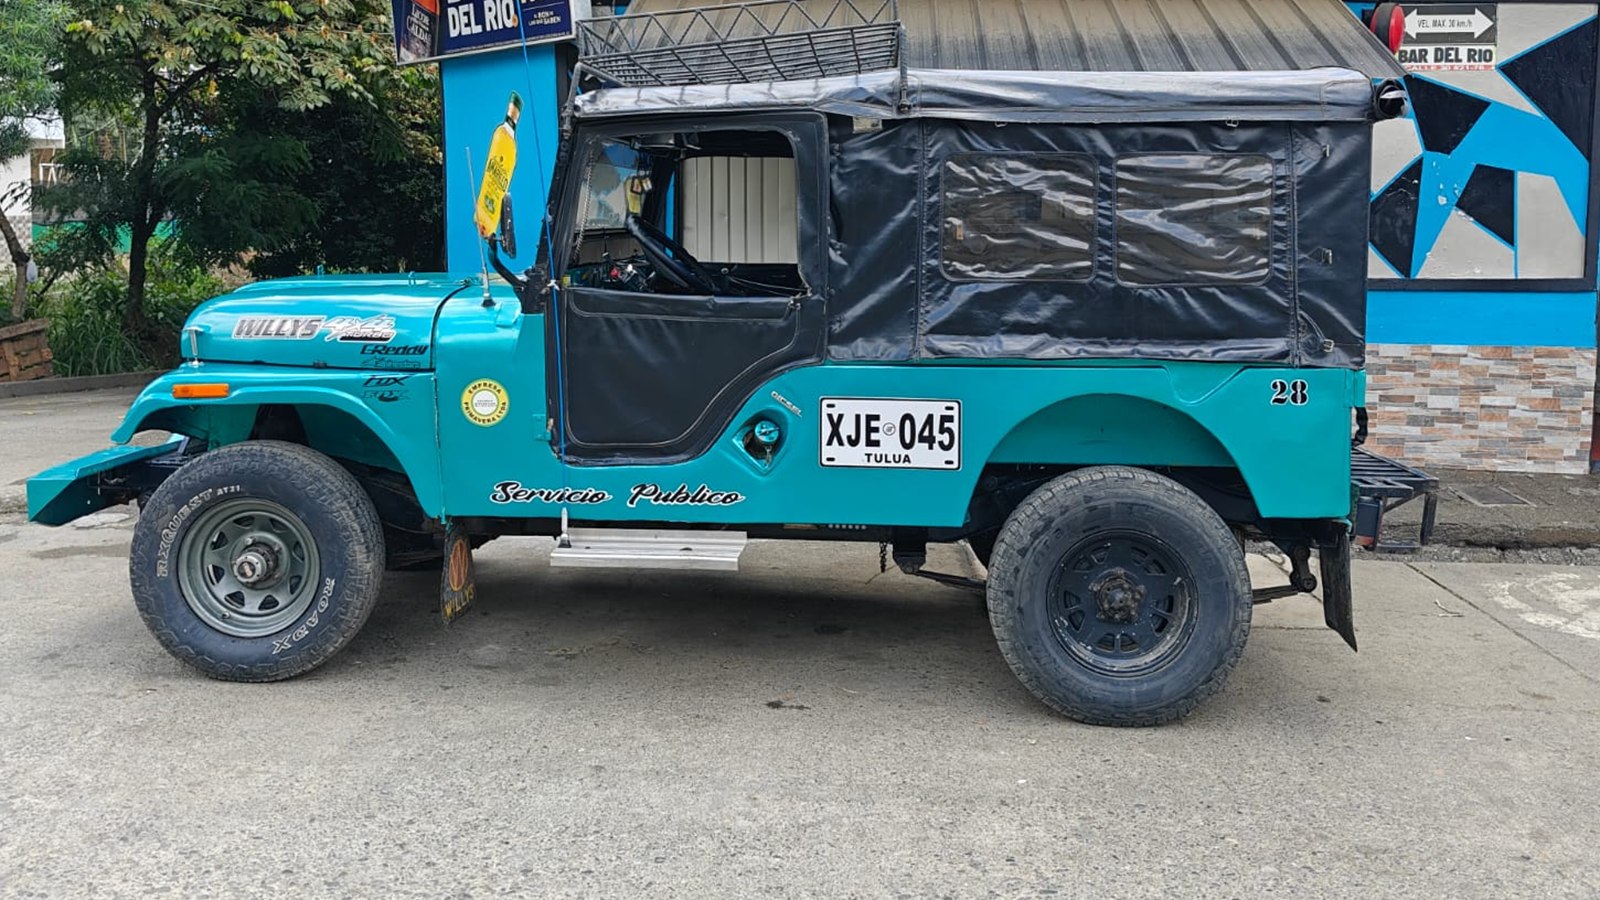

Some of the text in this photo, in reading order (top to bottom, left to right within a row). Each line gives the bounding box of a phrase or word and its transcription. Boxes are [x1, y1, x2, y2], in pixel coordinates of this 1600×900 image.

[447, 3, 482, 38] DEL
[1398, 47, 1493, 63] BAR DEL RIO
[233, 317, 323, 337] WILLYS
[468, 382, 502, 394] EMPRESA
[1271, 380, 1308, 405] 28
[826, 413, 955, 451] XJE 045
[865, 453, 912, 464] TULUA
[490, 481, 746, 507] Servicio Publico
[271, 577, 336, 655] ROADX
